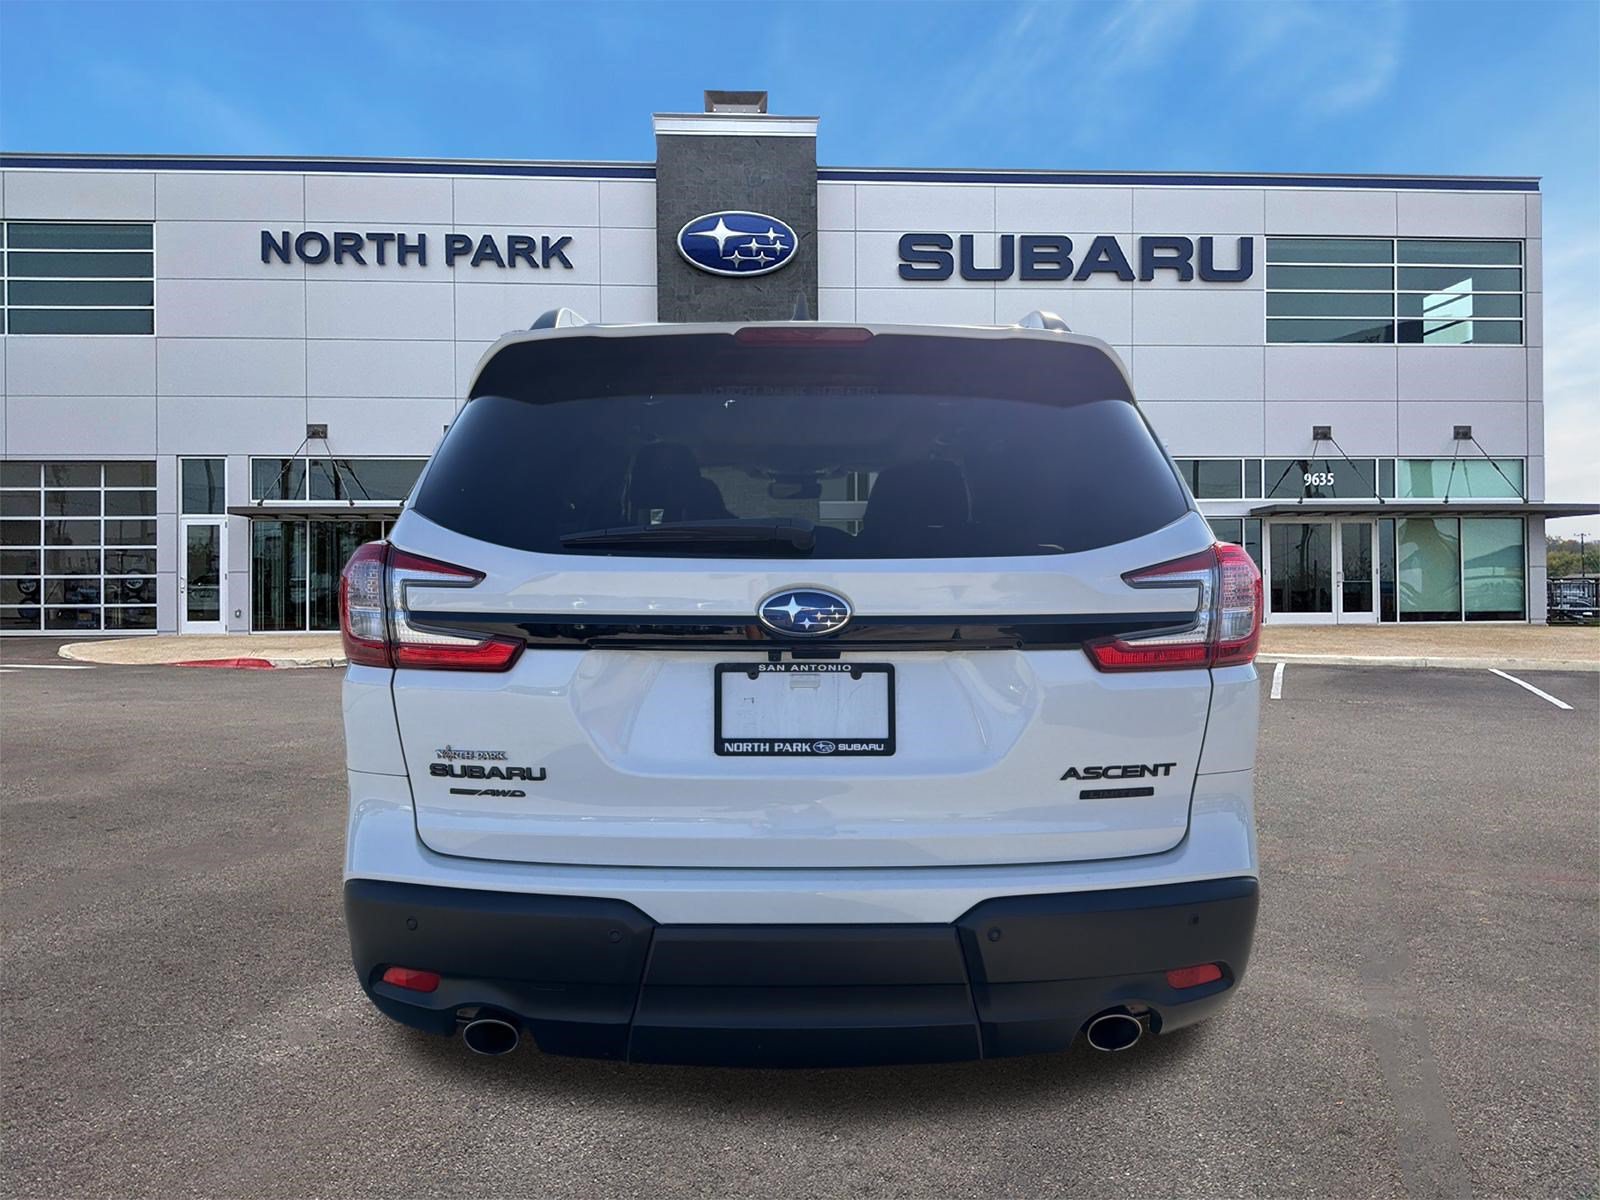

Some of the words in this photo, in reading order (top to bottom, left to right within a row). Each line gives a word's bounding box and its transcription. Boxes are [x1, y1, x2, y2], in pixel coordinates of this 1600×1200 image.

[260, 230, 427, 267] NORTH
[445, 233, 574, 270] PARK
[898, 233, 1254, 283] SUBARU
[1304, 472, 1334, 486] 9635
[724, 742, 769, 752] NORTH
[774, 742, 811, 752] PARK
[838, 743, 884, 751] SUBARU
[478, 750, 508, 760] PARK
[429, 763, 547, 781] SUBARU
[1060, 763, 1177, 780] ASCENT
[478, 789, 526, 797] AWD
